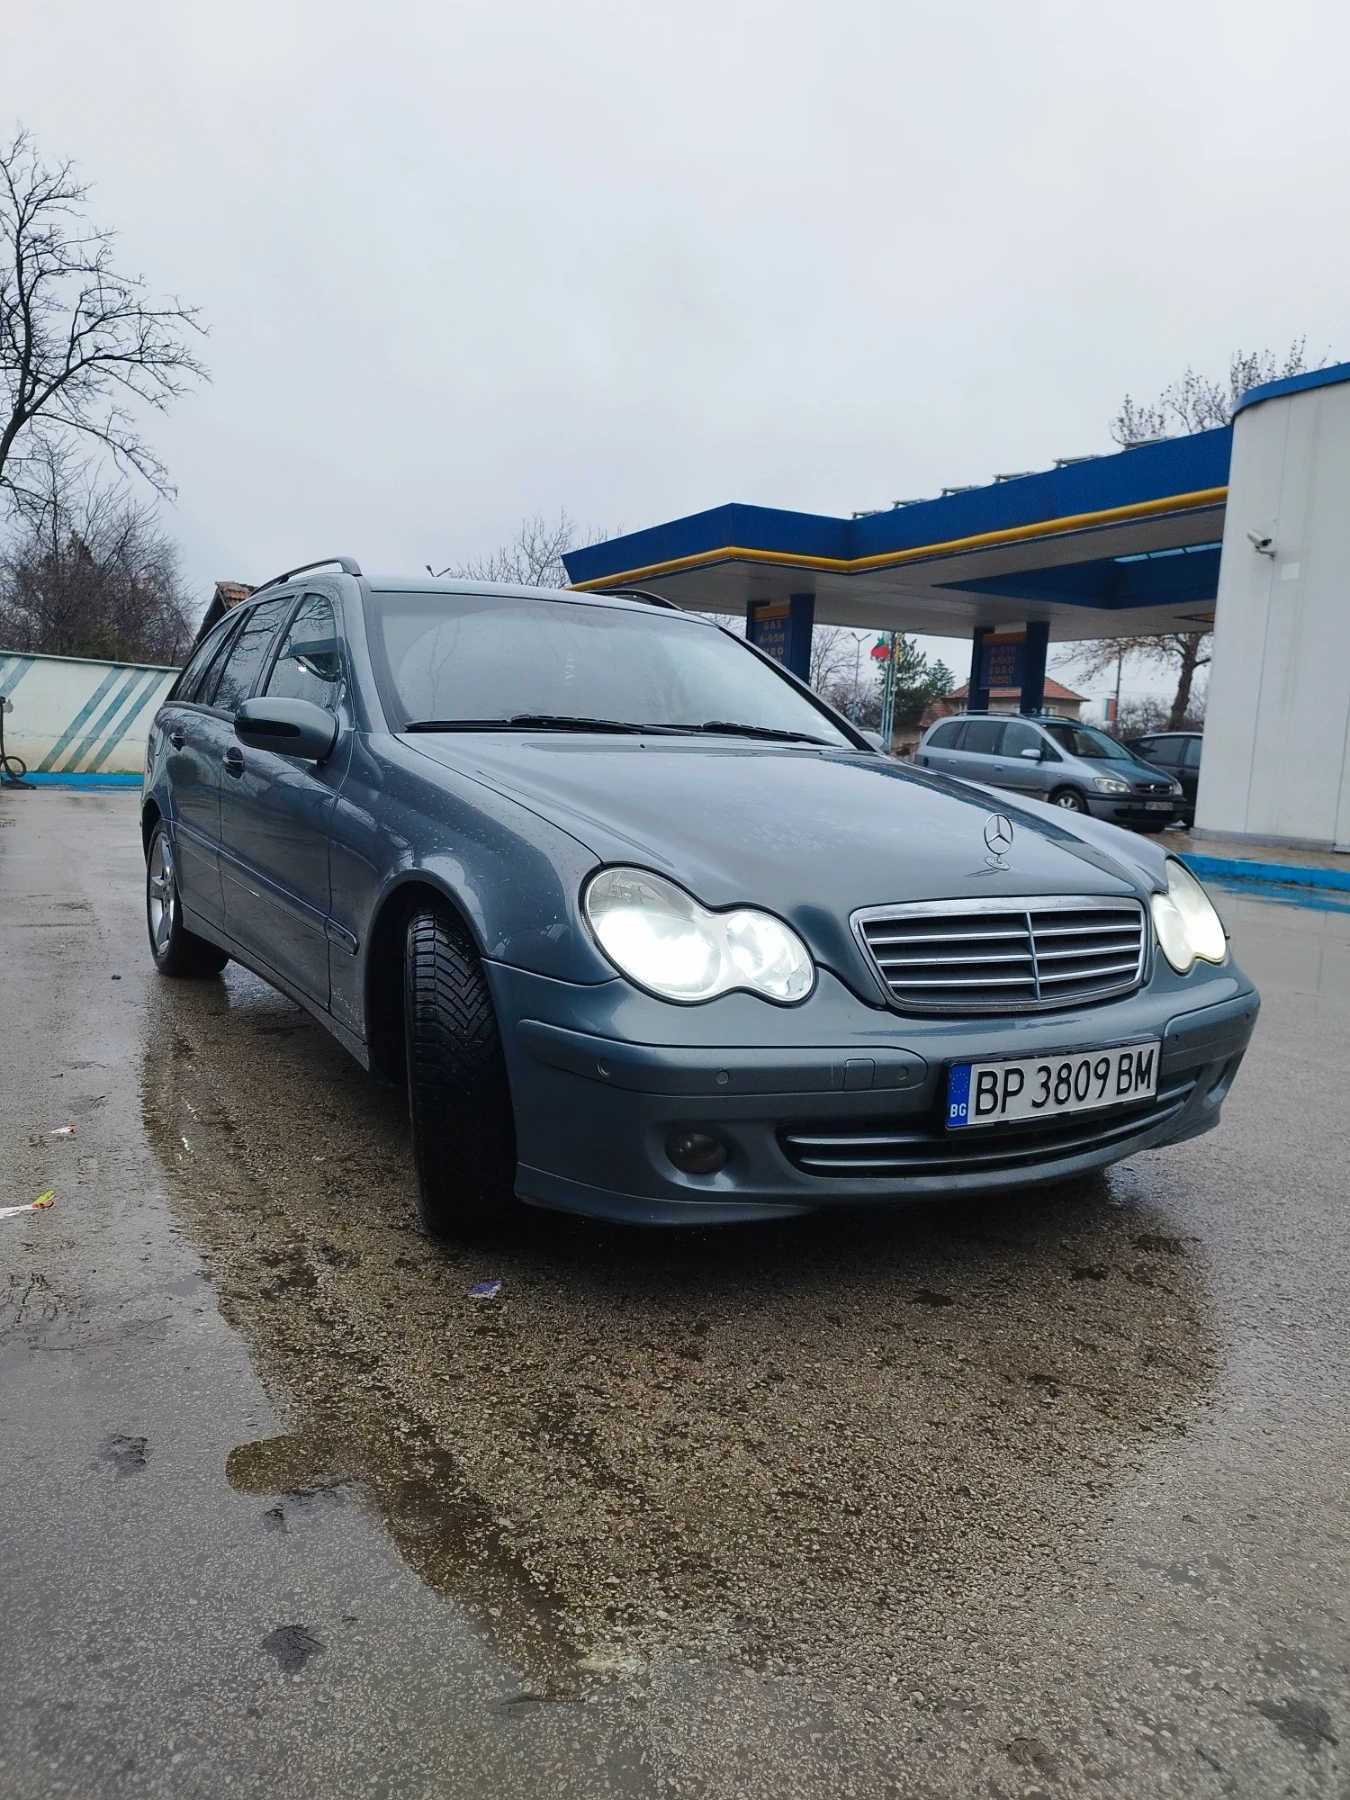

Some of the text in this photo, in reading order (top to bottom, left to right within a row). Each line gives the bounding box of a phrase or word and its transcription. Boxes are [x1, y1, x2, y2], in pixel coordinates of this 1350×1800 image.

[764, 620, 781, 629] GAS
[989, 665, 1014, 674] EURO
[975, 1049, 1155, 1116] BP 3809 BM
[950, 1103, 967, 1118] BG
